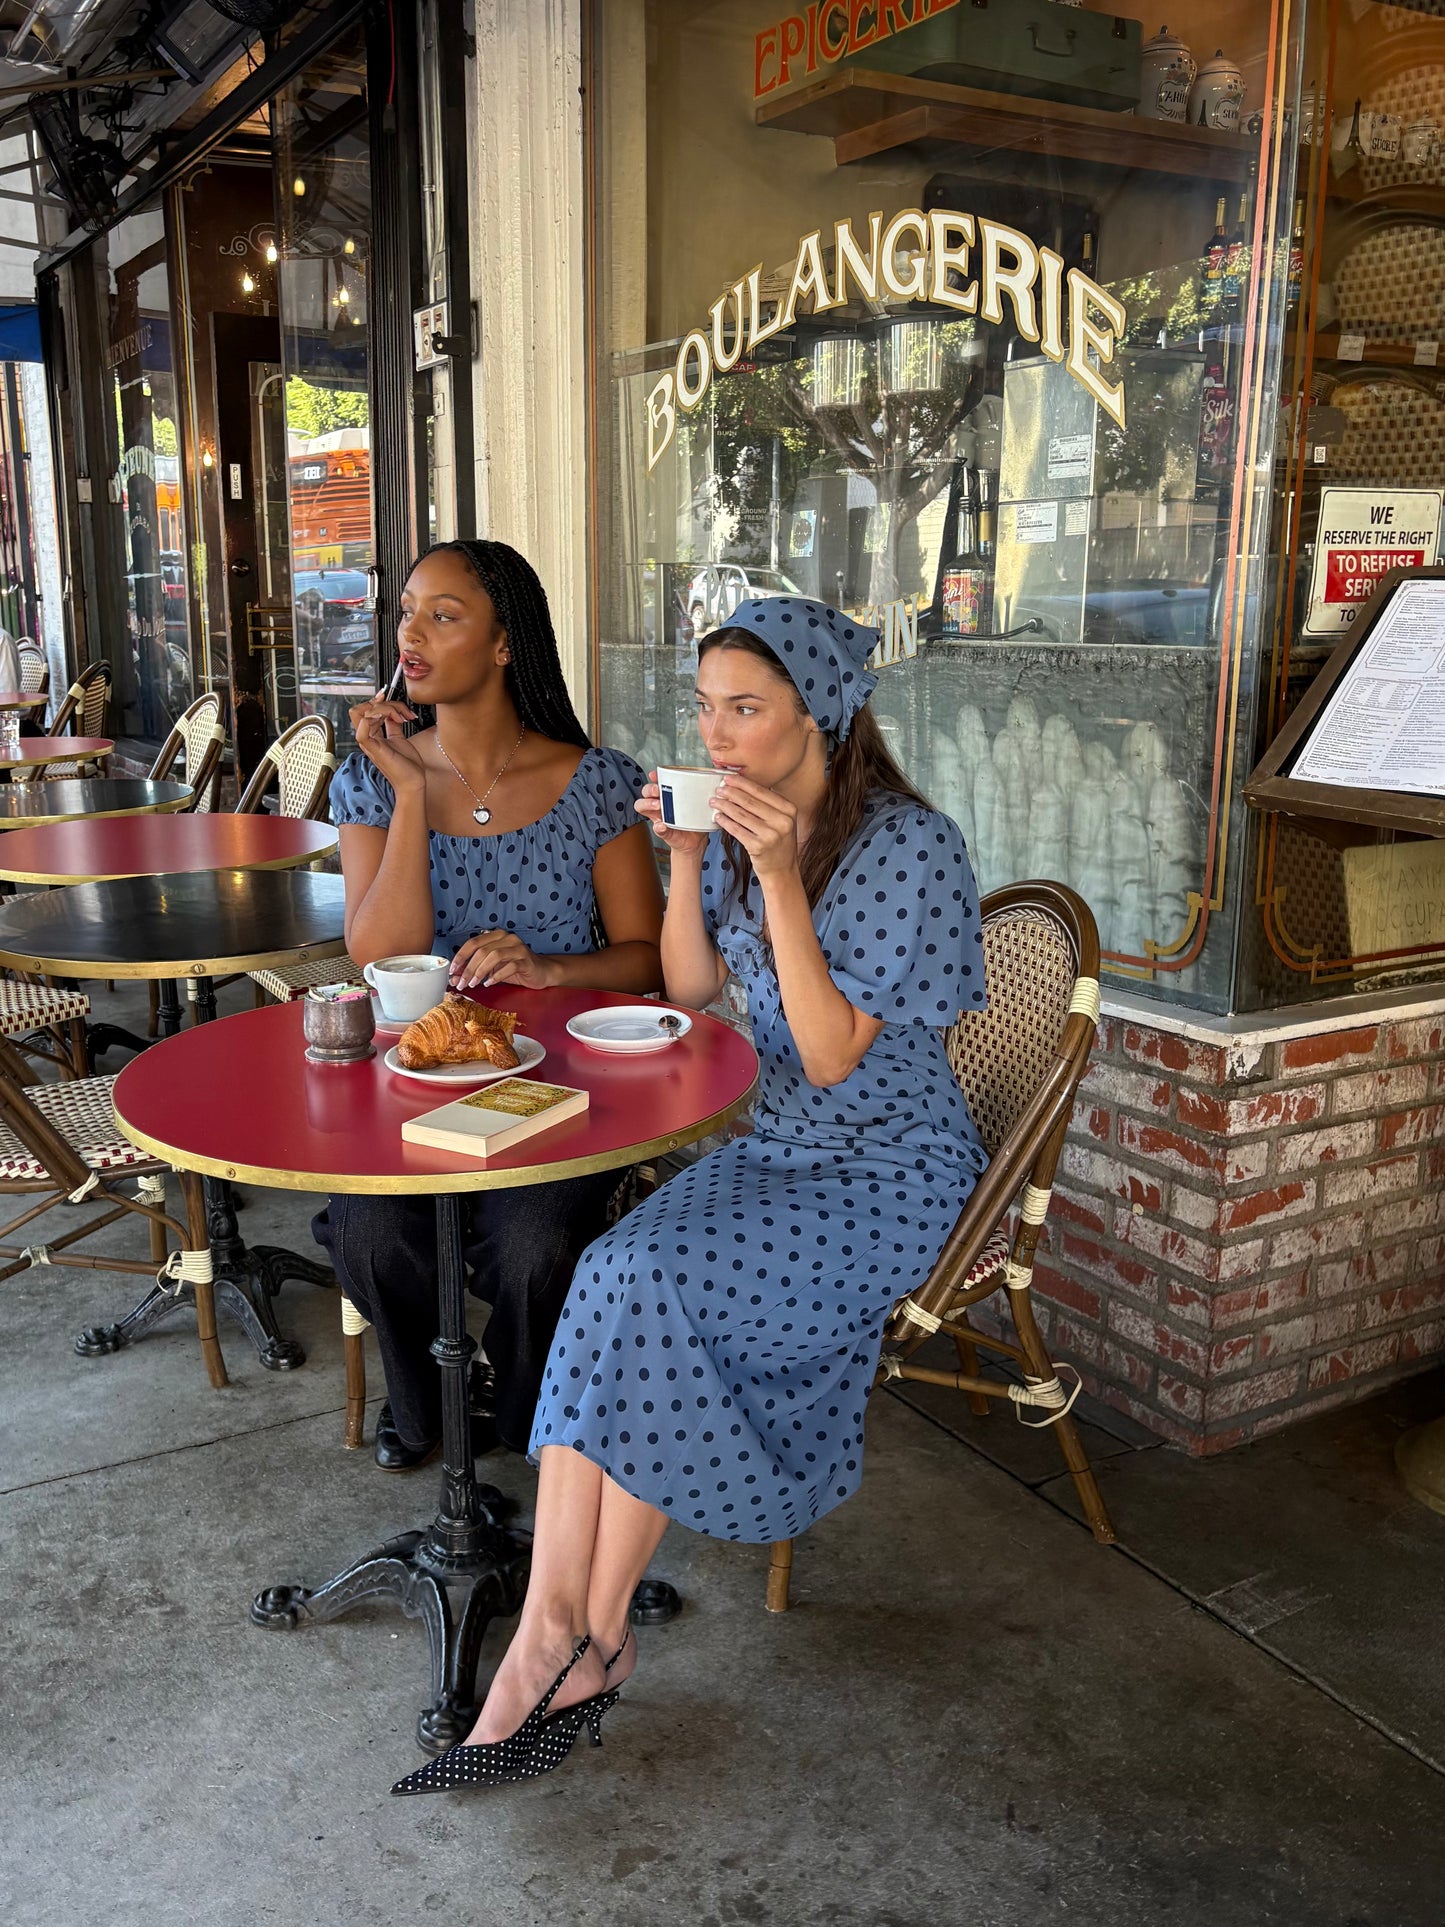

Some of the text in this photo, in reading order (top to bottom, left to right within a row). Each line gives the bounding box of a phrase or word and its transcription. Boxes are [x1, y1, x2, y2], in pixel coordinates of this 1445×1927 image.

[644, 208, 1127, 476] BOULANGERIE
[1204, 399, 1233, 423] Silk
[1370, 506, 1394, 525] WE
[1323, 530, 1433, 545] RESERVE THE RIGHT
[1336, 554, 1415, 573] TO REFUSE
[1344, 578, 1382, 597] SERV
[1340, 609, 1356, 622] TO
